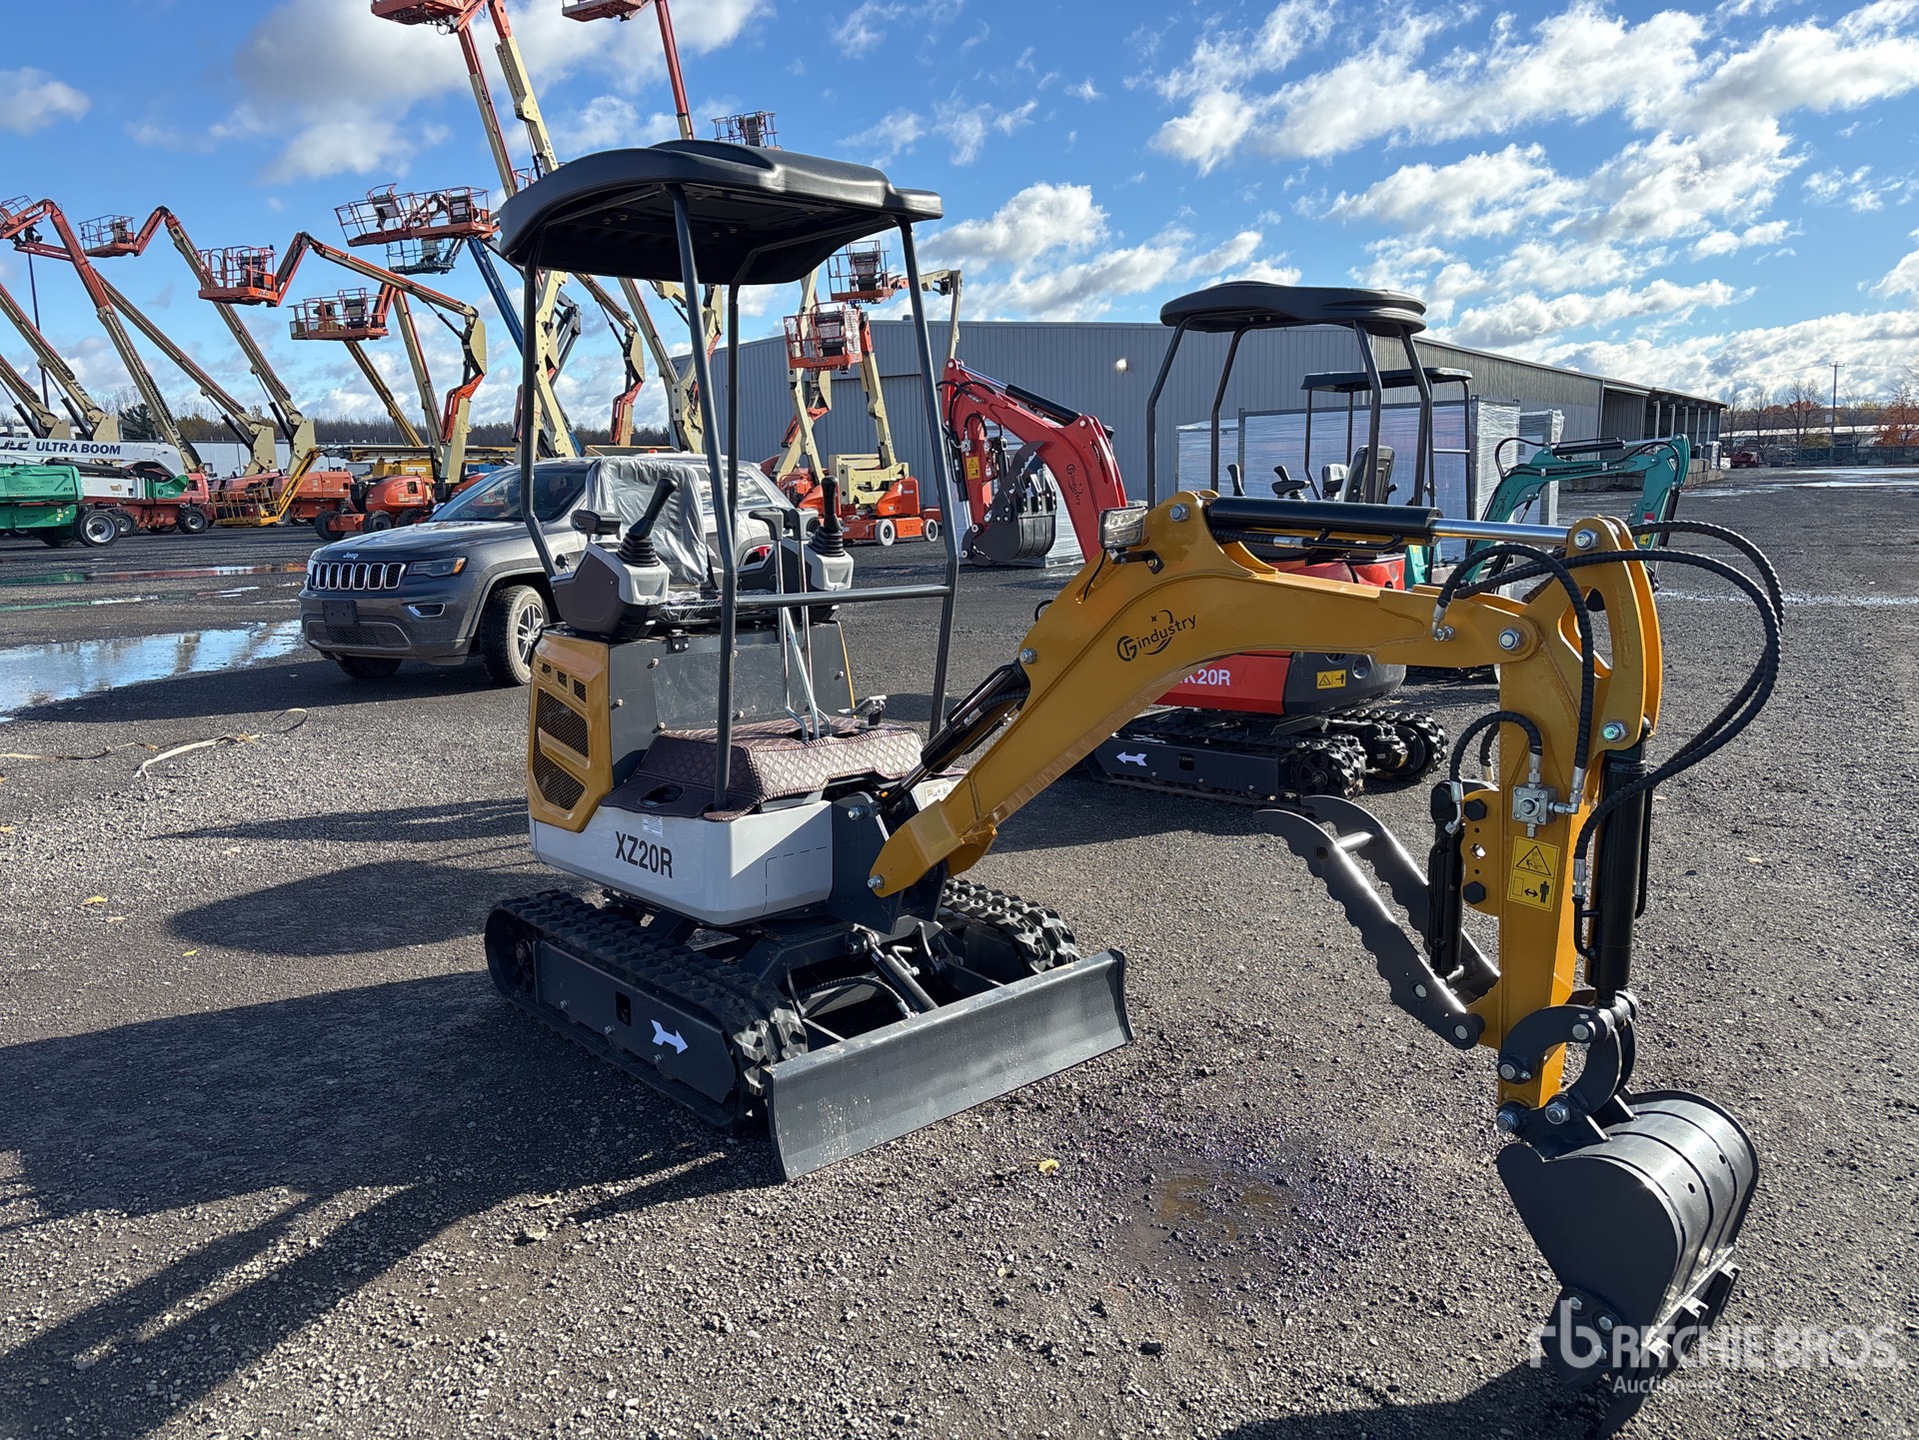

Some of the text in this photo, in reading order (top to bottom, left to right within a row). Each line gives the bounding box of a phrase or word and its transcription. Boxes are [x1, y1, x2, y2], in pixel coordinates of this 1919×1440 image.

[35, 441, 78, 453] ULTRA
[80, 444, 121, 455] BOOM
[342, 551, 359, 560] Jeep
[615, 830, 673, 879] XZ20R
